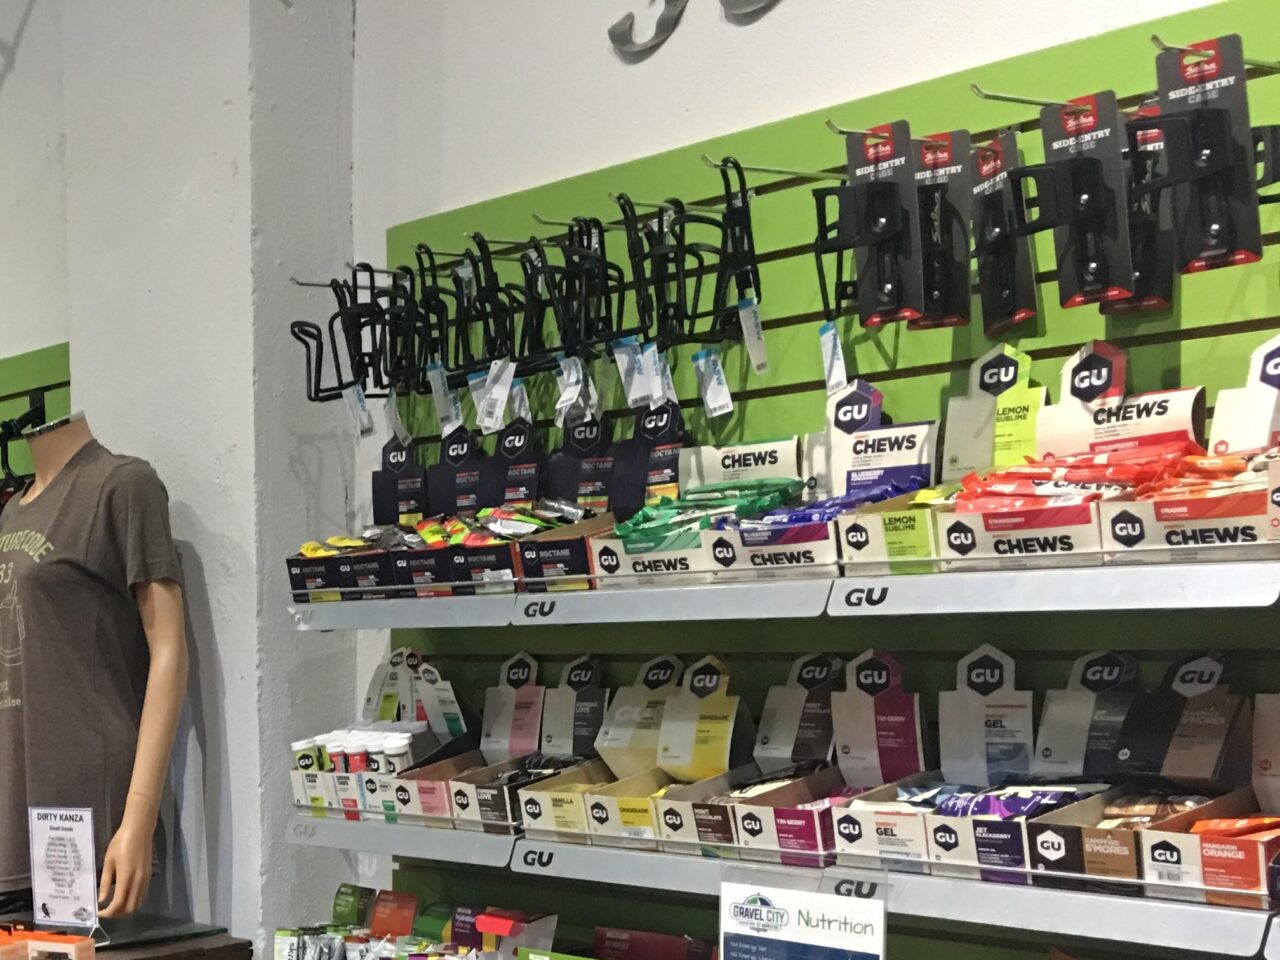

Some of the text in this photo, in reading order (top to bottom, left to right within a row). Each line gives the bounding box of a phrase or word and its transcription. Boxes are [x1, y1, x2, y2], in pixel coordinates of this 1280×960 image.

[983, 367, 1015, 384] GU
[1074, 368, 1109, 389] GU
[838, 404, 868, 422] GU
[996, 405, 1030, 416] LEMON
[1093, 400, 1169, 426] CHEWS
[644, 412, 669, 429] GU
[996, 413, 1030, 424] SUBLIME
[574, 426, 597, 440] GU
[504, 434, 525, 448] GU
[852, 434, 917, 455] CHEWS
[448, 442, 468, 456] GU
[389, 450, 407, 465] GU
[721, 450, 778, 469] CHEWS
[883, 516, 916, 525] LEMON
[884, 524, 916, 533] SUBLIME
[1114, 522, 1140, 536] GU
[848, 532, 867, 542] GU
[949, 532, 972, 545] GU
[1165, 526, 1258, 546] CHEWS
[993, 535, 1074, 555] CHEWS
[453, 554, 465, 565] GU
[524, 549, 537, 560] GU
[600, 553, 619, 567] GU
[713, 547, 734, 560] GU
[750, 550, 815, 567] CHEWS
[339, 563, 351, 573] GU
[396, 557, 408, 568] GU
[632, 557, 689, 573] CHEWS
[290, 566, 301, 575] GU
[844, 587, 889, 607] GU
[523, 600, 557, 618] GU
[509, 668, 529, 680] GU
[570, 670, 591, 682] GU
[647, 668, 671, 681] GU
[800, 666, 828, 680] GU
[859, 669, 888, 685] GU
[971, 668, 1000, 683] GU
[1086, 666, 1119, 681] GU
[1179, 670, 1215, 685] GU
[693, 674, 718, 688] GU
[985, 720, 1006, 728] GEL
[299, 757, 313, 767] GU
[397, 792, 409, 800] GU
[455, 796, 468, 804] GU
[525, 804, 542, 813] GU
[592, 810, 606, 818] GU
[37, 812, 84, 822] DIRTY KANZA
[665, 816, 681, 824] GU
[743, 819, 760, 830] GU
[839, 823, 860, 835] GU
[876, 828, 897, 838] GEL
[936, 833, 955, 844] GU
[1040, 840, 1062, 851] GU
[523, 850, 553, 867] GU
[1153, 850, 1178, 861] GU
[1203, 849, 1245, 860] ORANGE
[834, 879, 878, 899] GU
[733, 905, 785, 924] GRAVEL CITY
[798, 909, 874, 936] Nutrition
